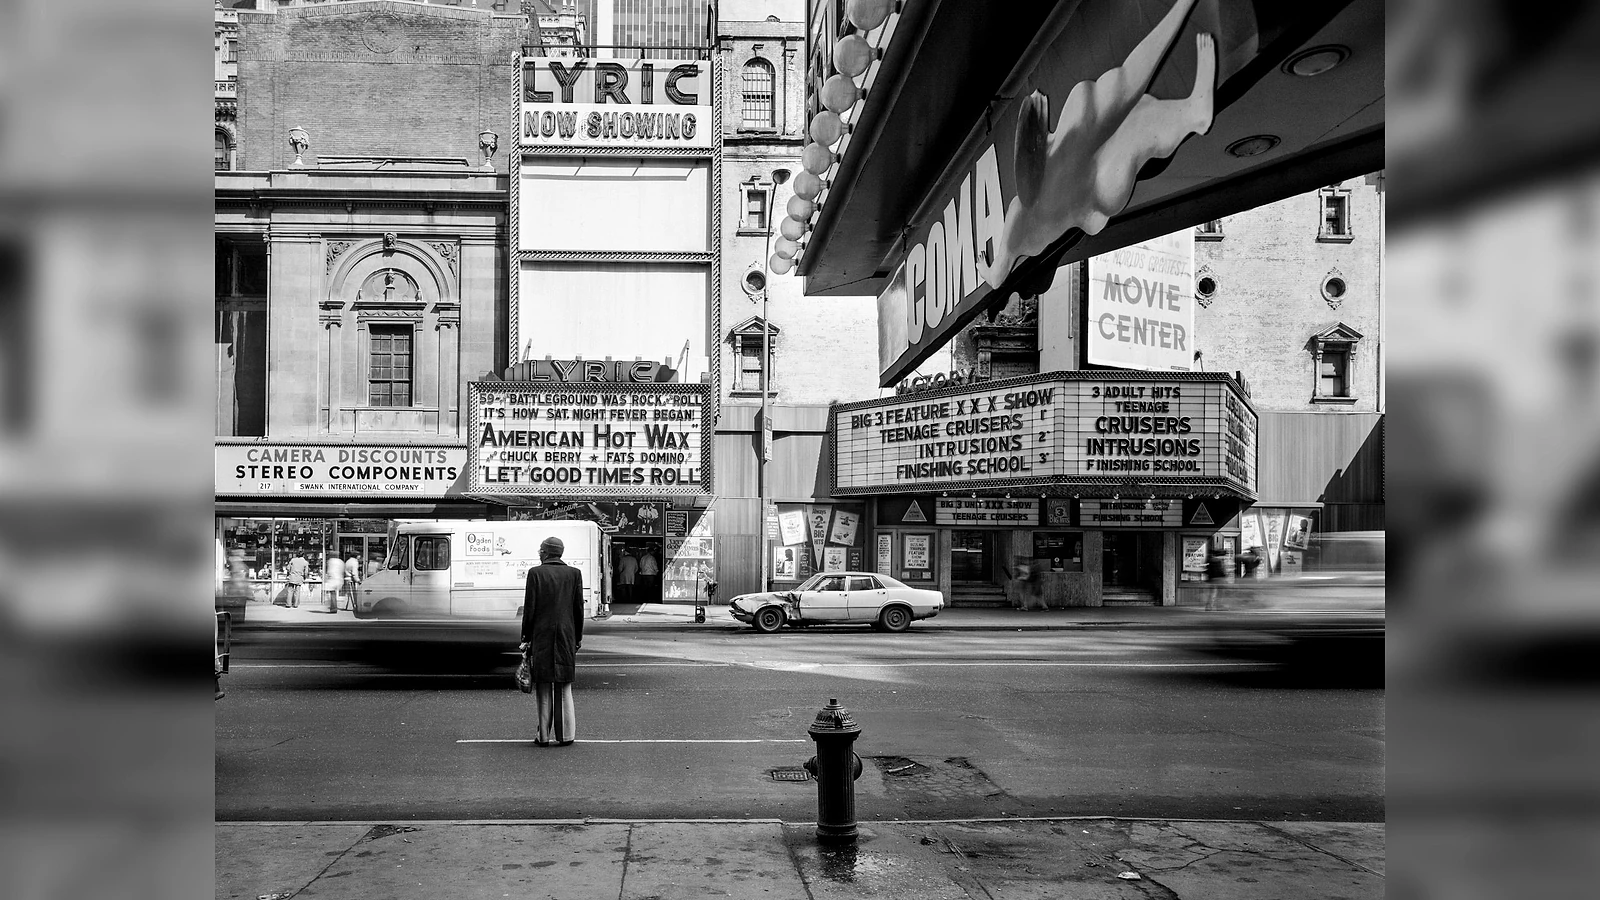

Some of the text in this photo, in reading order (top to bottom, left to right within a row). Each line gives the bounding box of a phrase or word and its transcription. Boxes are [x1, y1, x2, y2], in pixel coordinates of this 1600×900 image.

[523, 61, 699, 106] LYRIC
[524, 111, 697, 139] NOW SHOWING
[906, 143, 1005, 345] COMA
[1103, 272, 1181, 312] MOVIE
[1098, 312, 1186, 352] CENTER
[529, 359, 653, 383] LYRIC
[1092, 386, 1181, 399] 3 ADULT HITS
[509, 393, 598, 407] BATTLEGROUND
[601, 394, 627, 407] WAS
[632, 394, 662, 407] ROCK
[673, 394, 702, 407] ROLL
[1115, 400, 1170, 413] TEENAGE
[484, 407, 695, 421] IT'S HOW SAT. NIGHT FEVER BEGAN!
[851, 413, 872, 429] BIG
[875, 411, 883, 426] 3
[886, 402, 950, 424] FEATURE
[1004, 388, 1055, 410] SHOW
[880, 423, 940, 443] TEENAGE
[946, 413, 1023, 436] CRUISERS
[1095, 415, 1192, 435] CRUISERS
[593, 424, 637, 450] HOT
[920, 434, 1023, 459] INTRUSIONS
[1086, 437, 1201, 457] INTRUSIONS
[247, 449, 447, 464] CAMERA DISCOUNTS
[500, 451, 538, 463] CHUCK
[545, 451, 582, 463] BERRY
[606, 452, 635, 464] FATS
[639, 452, 685, 465] DOMINO
[235, 465, 457, 481] STEREO COMPONENTS
[896, 460, 963, 479] FINISHING
[967, 456, 1031, 475] SCHOOL
[1087, 459, 1201, 473] FINISHING SCHOOL
[530, 466, 582, 484] GOOD
[585, 467, 645, 485] TIMES
[259, 482, 271, 490] 217
[328, 483, 381, 491] INTERNATIONAL
[384, 483, 419, 491] COMPANY
[940, 500, 954, 508] BIG
[956, 500, 962, 508] 3
[985, 500, 1004, 509] XXX
[1007, 500, 1032, 509] SHOW
[1099, 502, 1147, 510] INTRUSIONS
[814, 515, 824, 529] 2
[952, 513, 1029, 521] TEENAGE CRUISERS
[1092, 514, 1165, 522] FINISHING SCHOOL
[813, 529, 825, 538] BIG
[1269, 520, 1278, 533] 2
[467, 533, 492, 545] Ogden
